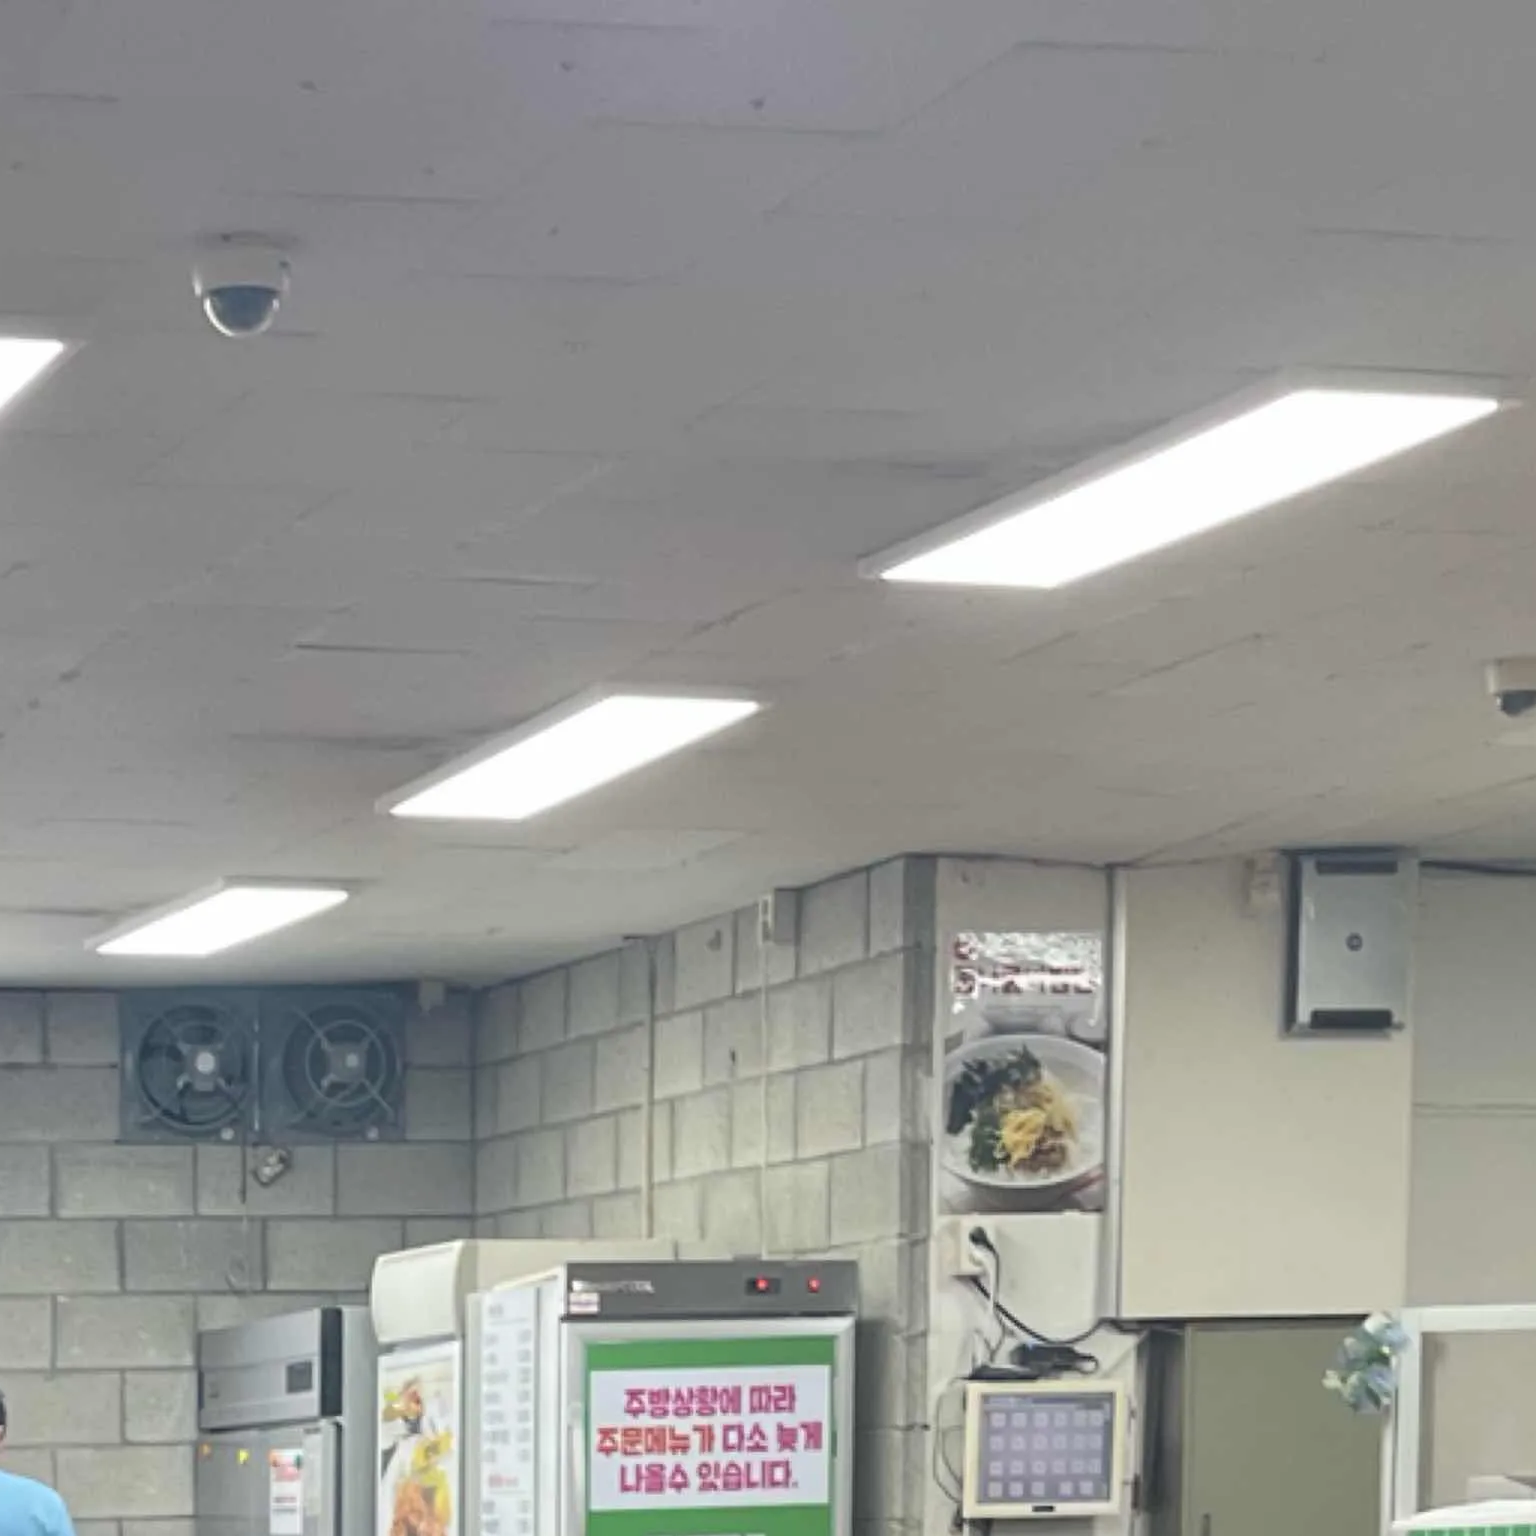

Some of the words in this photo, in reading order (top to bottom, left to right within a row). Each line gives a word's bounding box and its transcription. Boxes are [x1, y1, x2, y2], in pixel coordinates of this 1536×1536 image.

[623, 1385, 742, 1419] 주방상황에
[748, 1383, 797, 1415] 따라
[595, 1423, 716, 1457] 주문메뉴가
[721, 1420, 770, 1453] 다소
[775, 1420, 824, 1454] 늦게
[696, 1459, 800, 1492] 있습니다.
